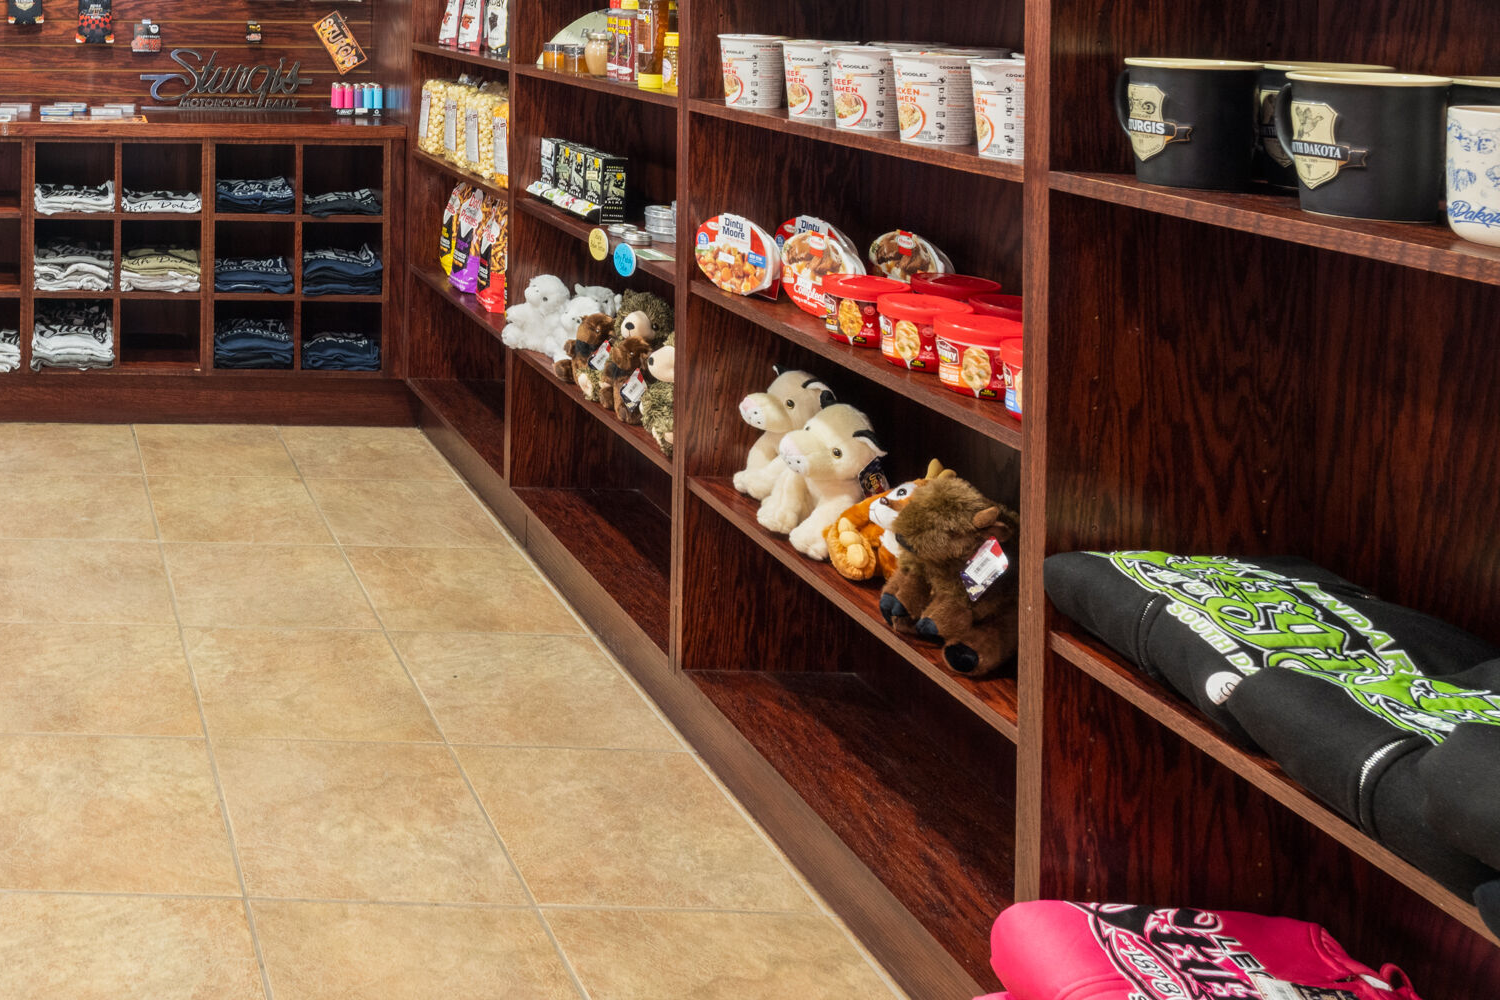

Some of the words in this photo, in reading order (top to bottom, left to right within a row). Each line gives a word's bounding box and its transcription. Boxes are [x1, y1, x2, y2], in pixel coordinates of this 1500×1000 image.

[319, 16, 359, 69] STURGIS
[141, 48, 312, 108] Sturgis
[179, 98, 254, 108] MOTORCYCLE
[265, 98, 300, 109] RALLY
[1303, 143, 1342, 159] DAKOTA
[724, 217, 745, 232] Dinty
[800, 219, 821, 233] Dinty
[721, 226, 746, 241] Moore
[1164, 600, 1240, 653] SOUTH
